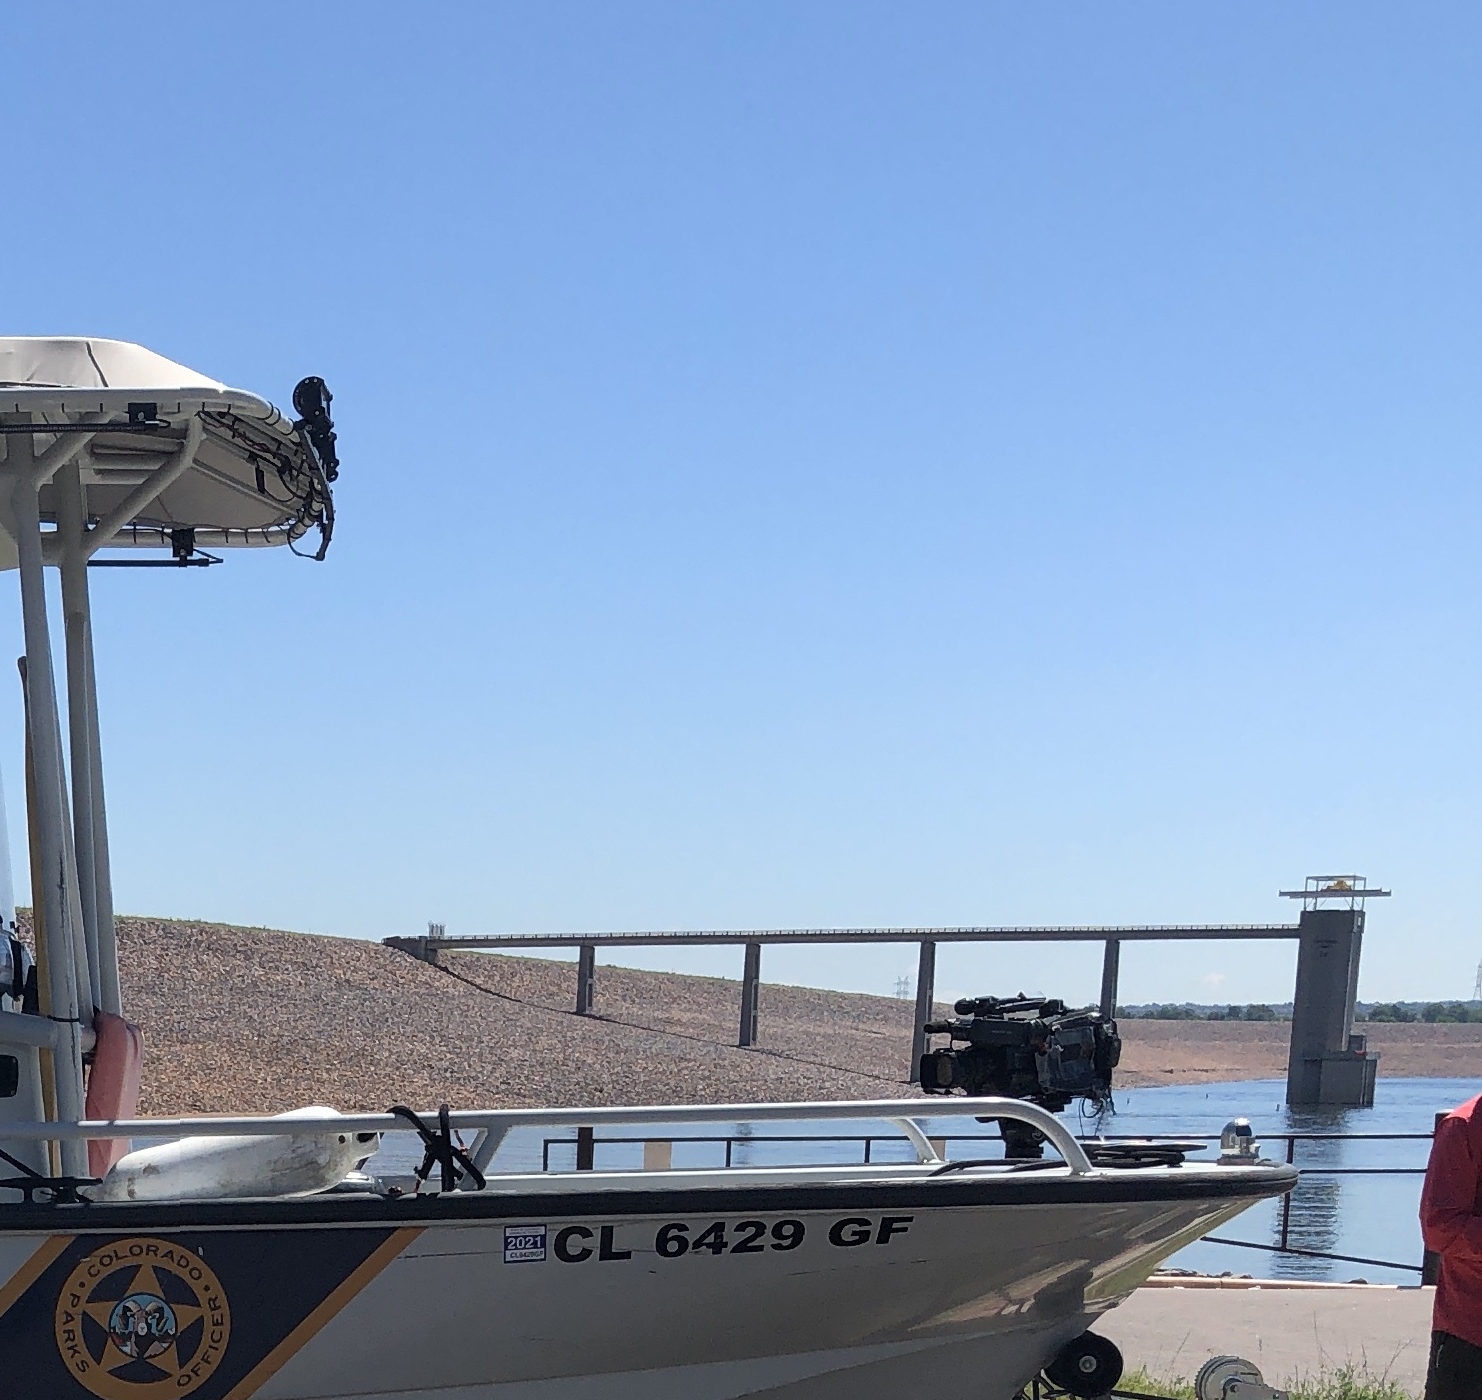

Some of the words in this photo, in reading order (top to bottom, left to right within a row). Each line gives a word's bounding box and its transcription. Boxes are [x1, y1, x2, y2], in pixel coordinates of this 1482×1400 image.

[87, 1244, 203, 1281] COLORADO
[507, 1235, 541, 1250] 2021
[554, 1225, 632, 1264] CL
[655, 1219, 806, 1258] 6429
[829, 1216, 915, 1247] GF
[62, 1292, 90, 1373] PARKS
[176, 1293, 224, 1388] OFFICER
